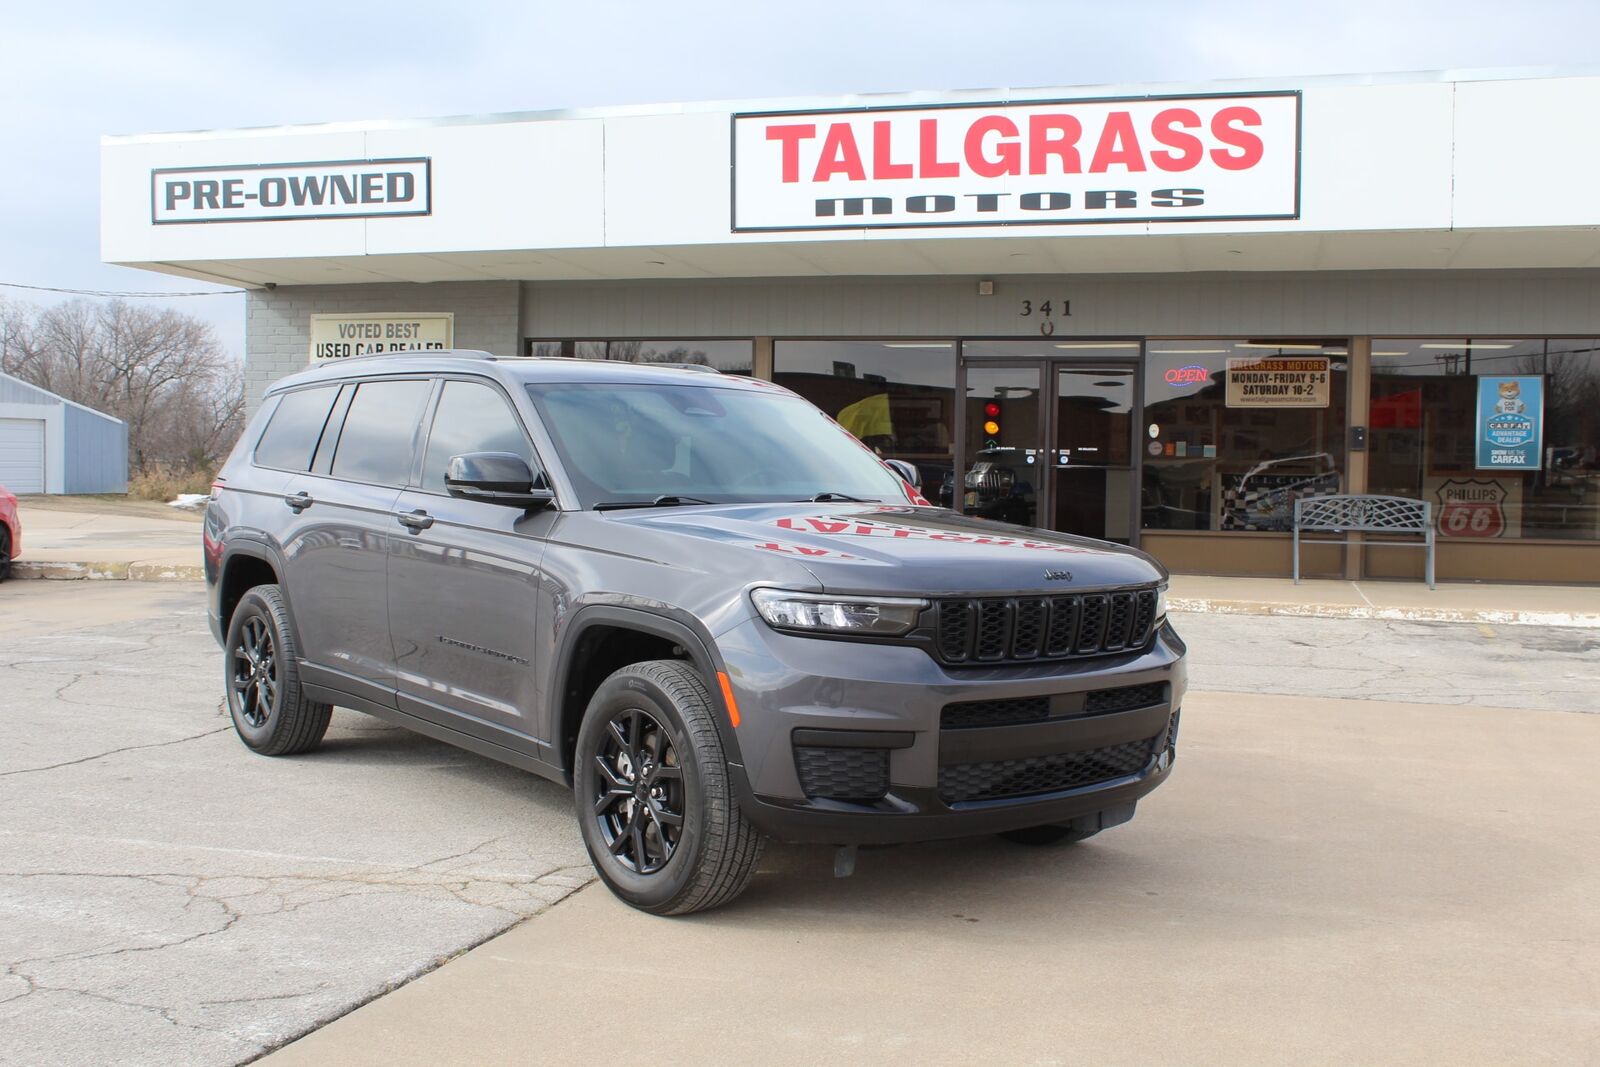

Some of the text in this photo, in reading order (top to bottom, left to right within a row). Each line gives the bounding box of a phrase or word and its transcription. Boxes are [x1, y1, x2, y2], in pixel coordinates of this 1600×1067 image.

[766, 106, 1264, 183] TALLGRASS
[165, 172, 415, 210] PRE-OWNED
[815, 188, 1205, 217] MOTORS
[1020, 300, 1072, 316] 341
[339, 323, 420, 338] VOTED BEST
[317, 343, 350, 358] USED
[1231, 360, 1325, 370] TALLGRASS MOTORS
[1164, 369, 1207, 382] OPEN
[1232, 373, 1325, 383] MONDAY-FRIDAY 9-6
[1243, 384, 1314, 395] SATURDAY 10-2
[1491, 455, 1525, 464] CARFAX
[1446, 488, 1497, 500] PHILLIPS
[1448, 507, 1492, 531] 66
[1044, 568, 1073, 582] Jeep
